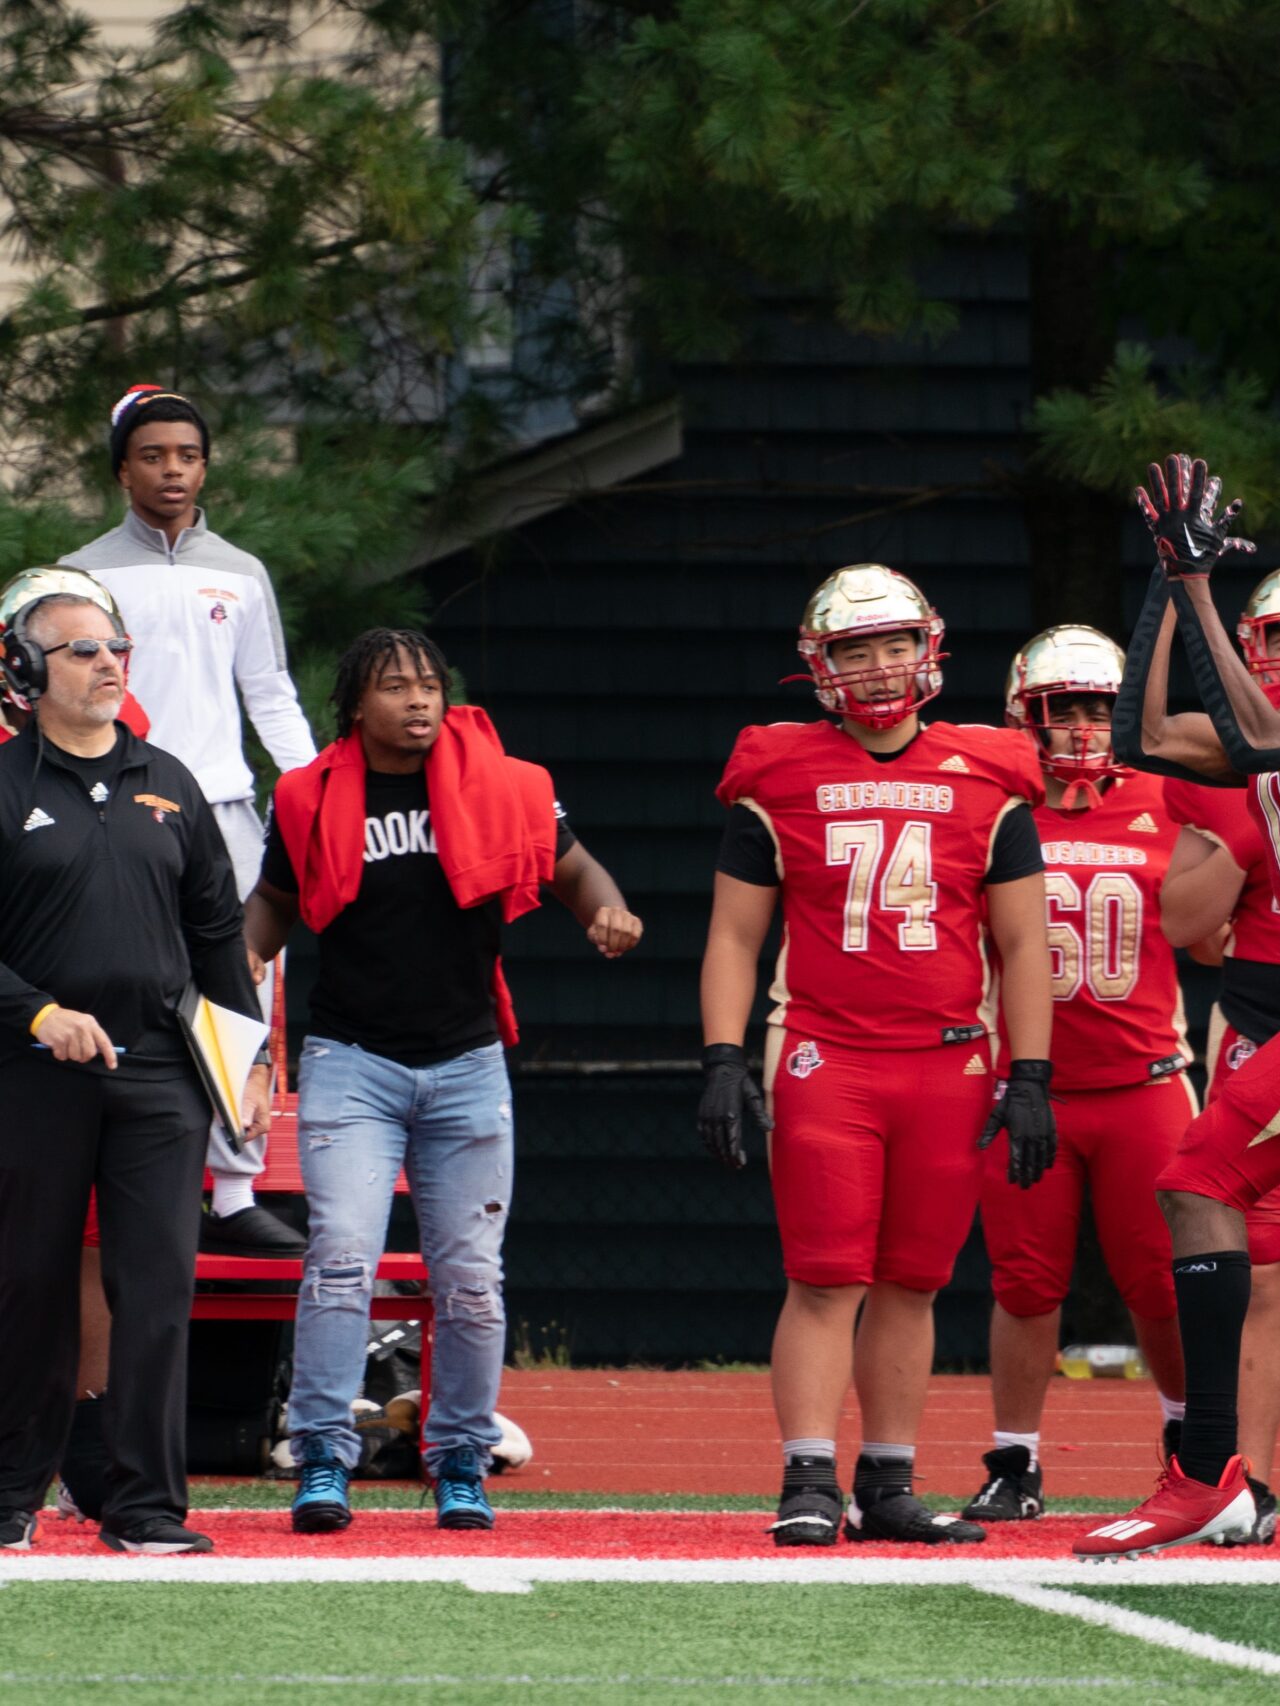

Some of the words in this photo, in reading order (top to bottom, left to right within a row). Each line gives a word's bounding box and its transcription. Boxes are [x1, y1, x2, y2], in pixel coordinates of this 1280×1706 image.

[816, 781, 954, 813] CRUSADERS
[362, 809, 438, 862] OOK
[1041, 842, 1147, 866] USADERS
[825, 820, 938, 952] 74
[1044, 872, 1143, 1001] 60
